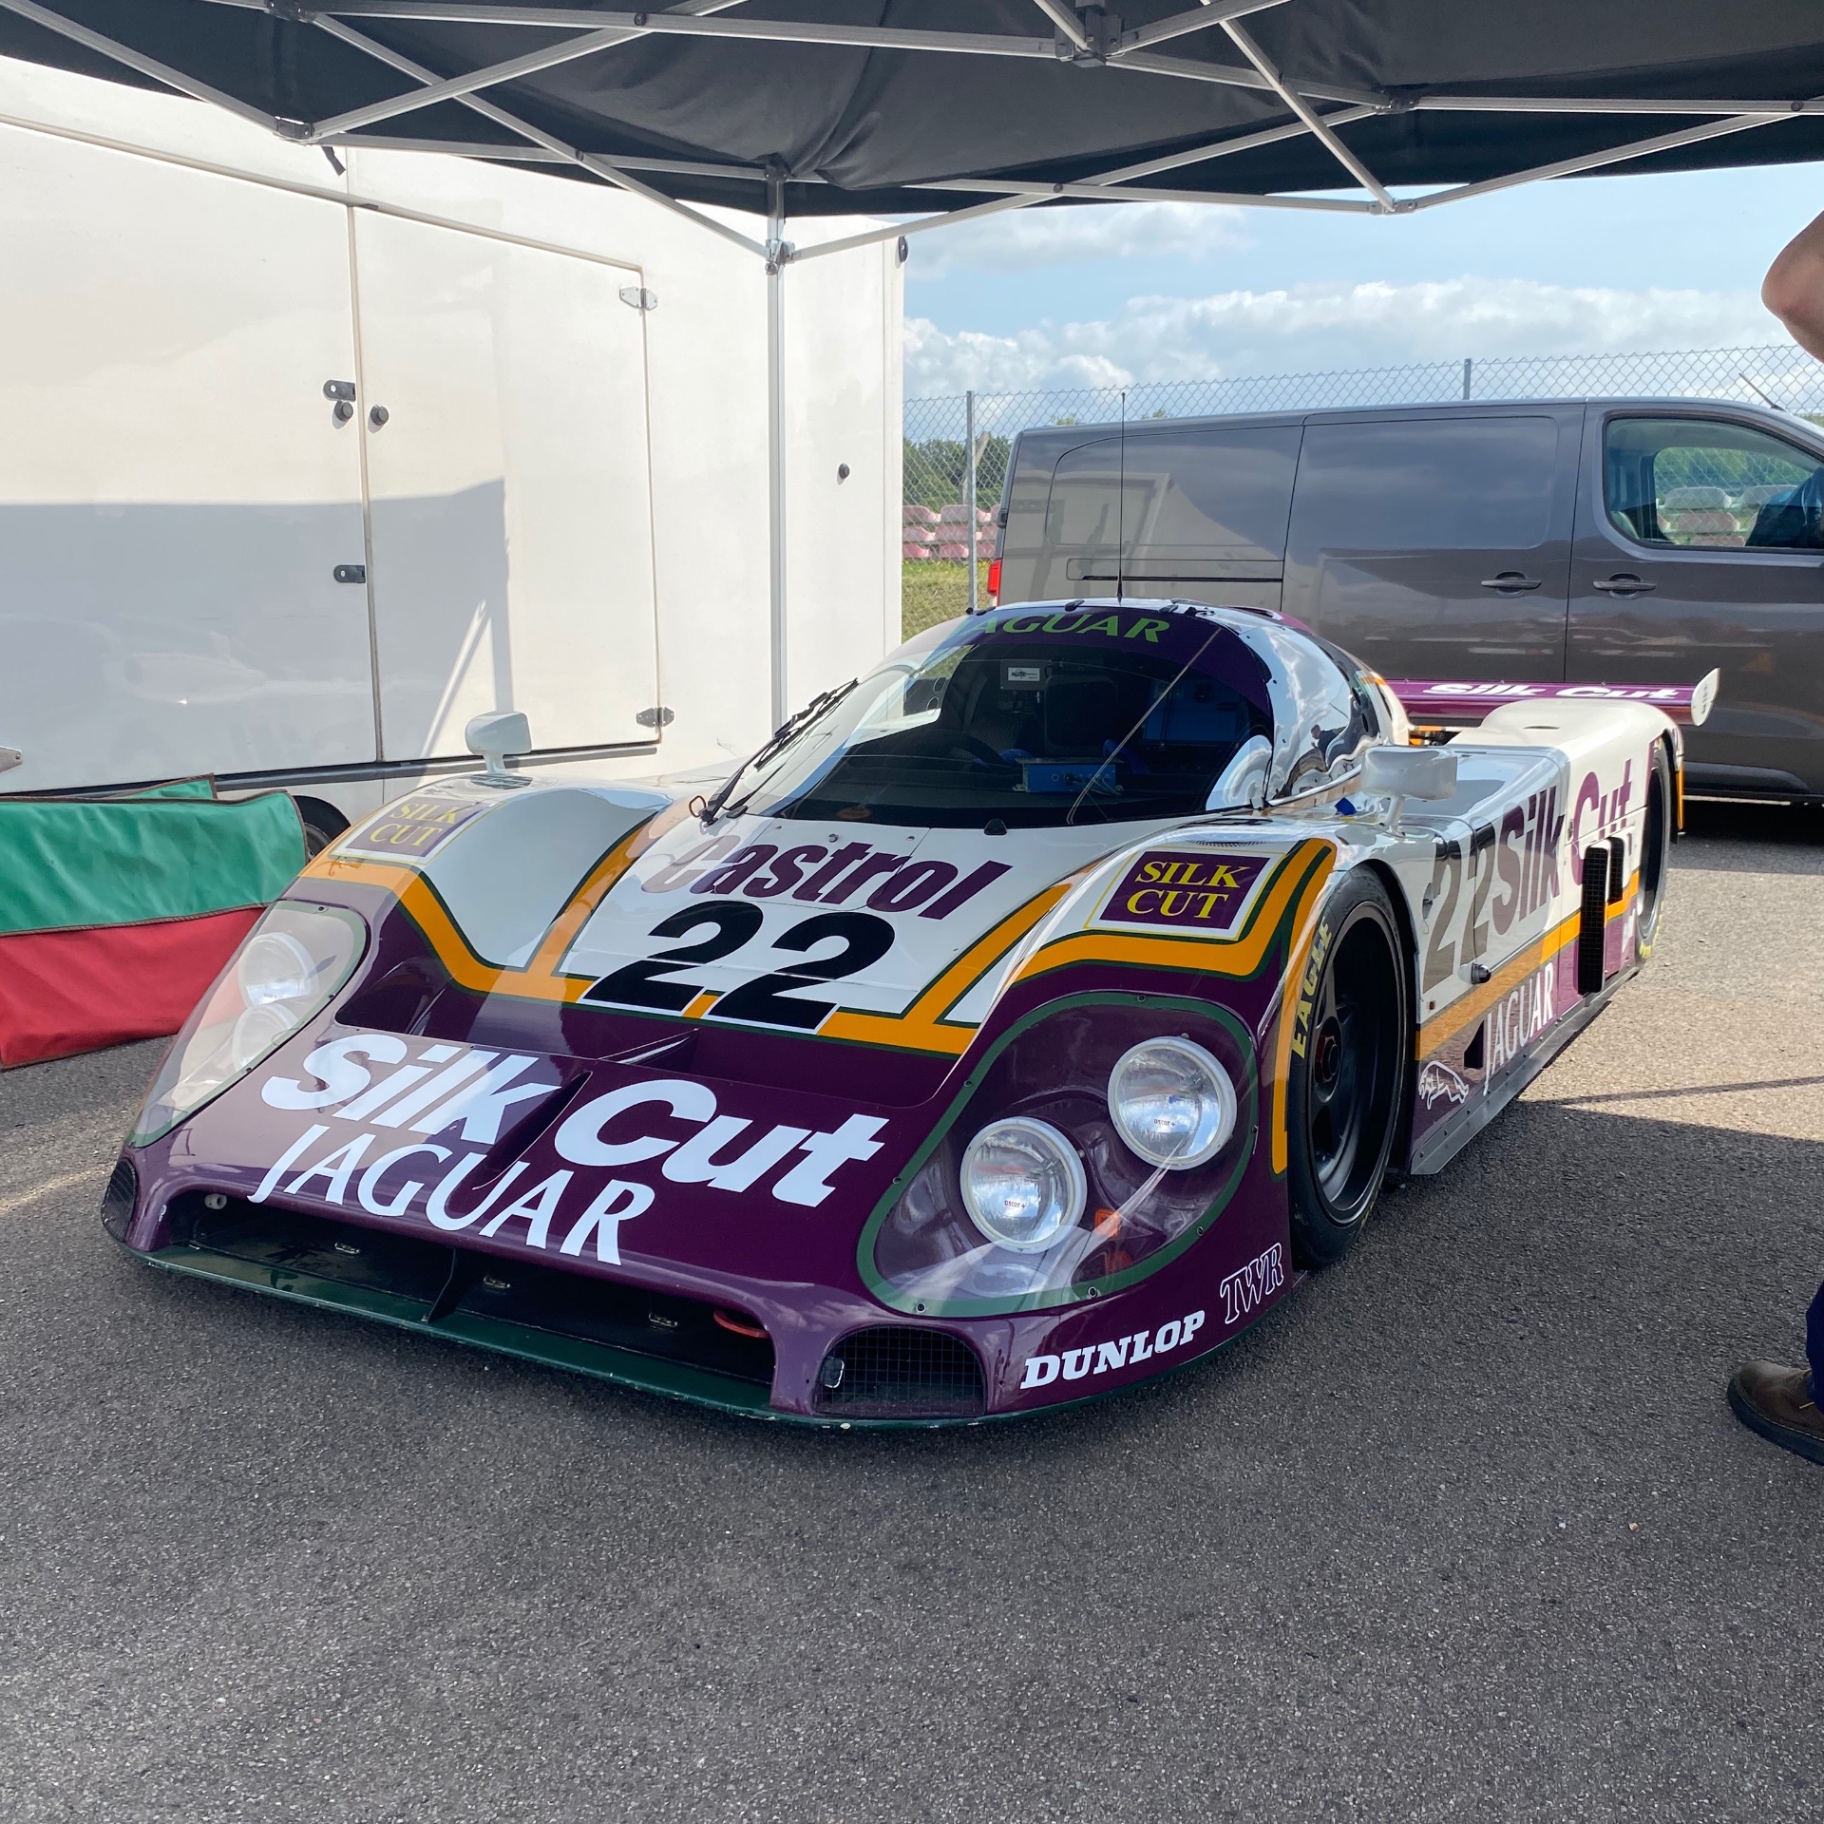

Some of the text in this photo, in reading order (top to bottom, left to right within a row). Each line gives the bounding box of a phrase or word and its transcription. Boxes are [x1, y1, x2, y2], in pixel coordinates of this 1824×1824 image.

[1423, 683, 1679, 699] Silk Cut
[370, 823, 443, 846] CUT
[389, 803, 471, 824] SILK
[641, 834, 1014, 920] Castrol
[1126, 889, 1229, 919] CUT
[1135, 861, 1250, 888] SILK
[1423, 821, 1496, 994] 22
[1492, 785, 1566, 935] Silk
[582, 900, 896, 1030] 22
[1292, 916, 1332, 1059] EAGLE
[1483, 962, 1554, 1096] JAGUAR
[261, 1034, 889, 1208] Silk Cut
[247, 1124, 656, 1266] JAGUAR
[1219, 1242, 1284, 1324] TWR
[1020, 1310, 1205, 1389] DUNLOP
